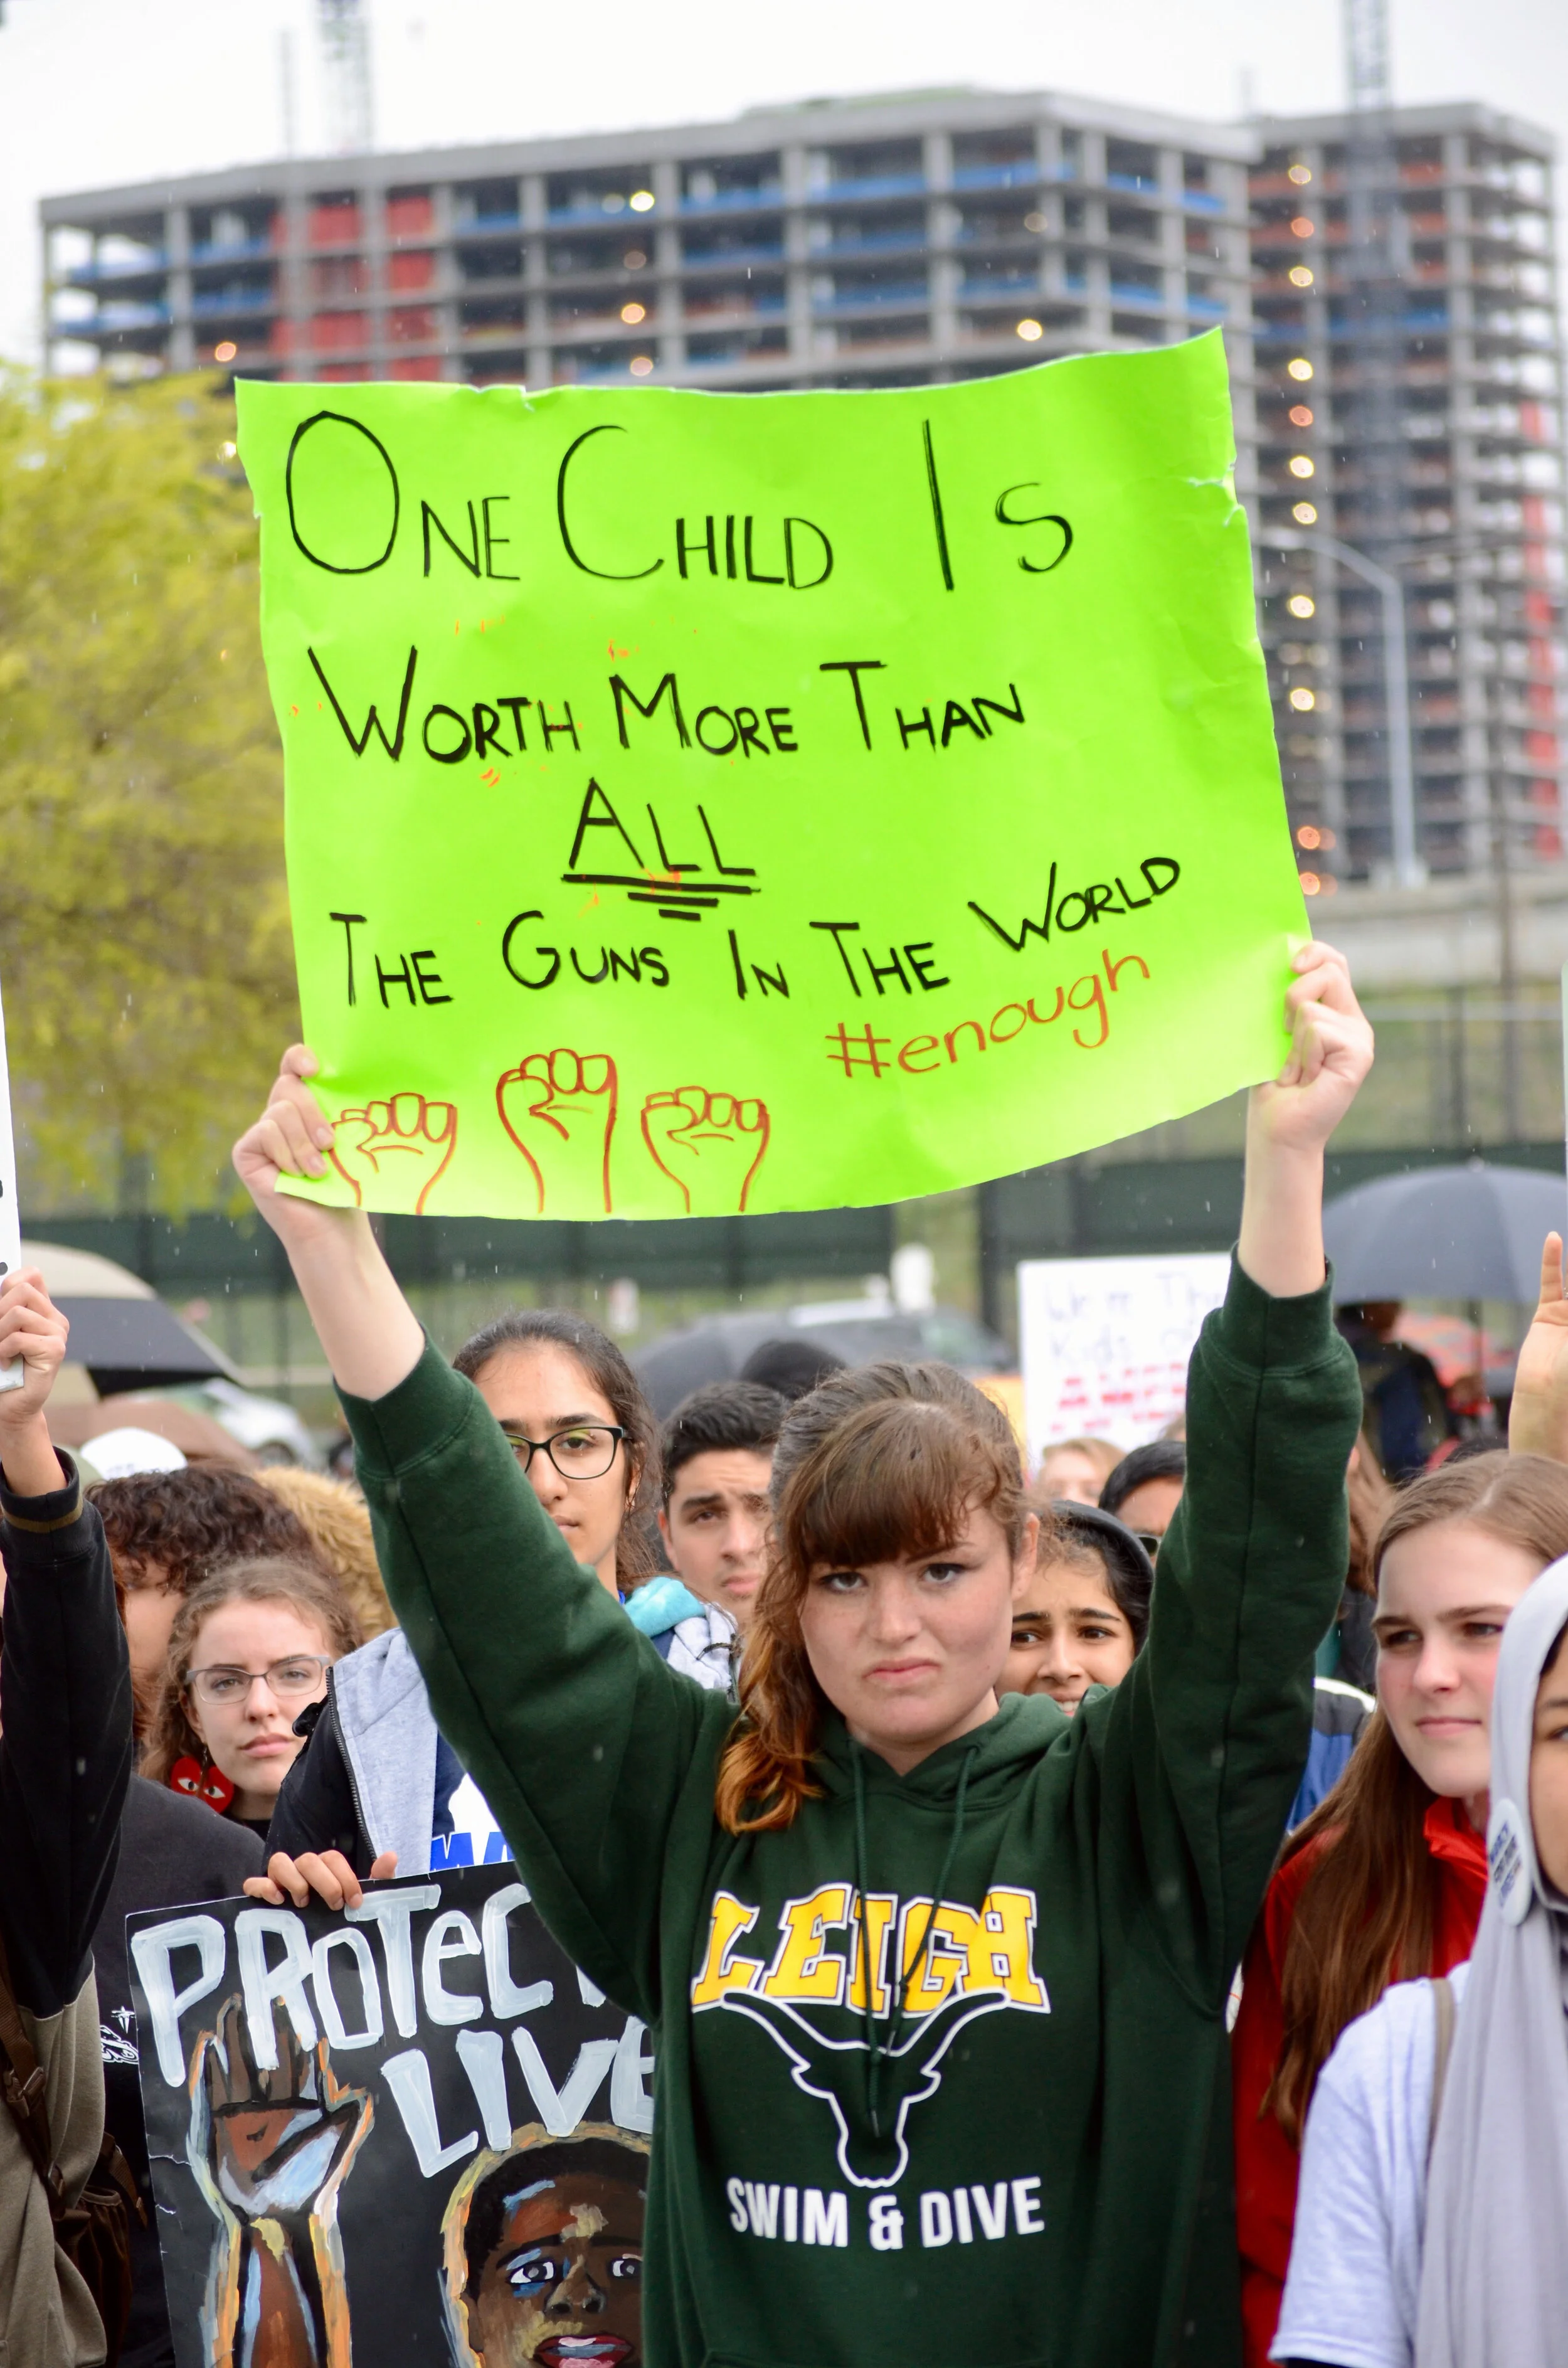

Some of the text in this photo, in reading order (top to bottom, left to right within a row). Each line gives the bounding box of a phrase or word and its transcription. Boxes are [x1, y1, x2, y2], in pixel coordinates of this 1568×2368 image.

[286, 411, 1072, 590] ONE CHILD IS
[308, 645, 1024, 763] WORTH MORE THAN
[569, 778, 755, 875] ALL
[330, 857, 1179, 1007] THE GUNS IN THE WORLD
[827, 950, 1150, 1077] #enough
[691, 1882, 1050, 2019] LEIGH
[729, 2177, 1044, 2250] SWIM & DIVE
